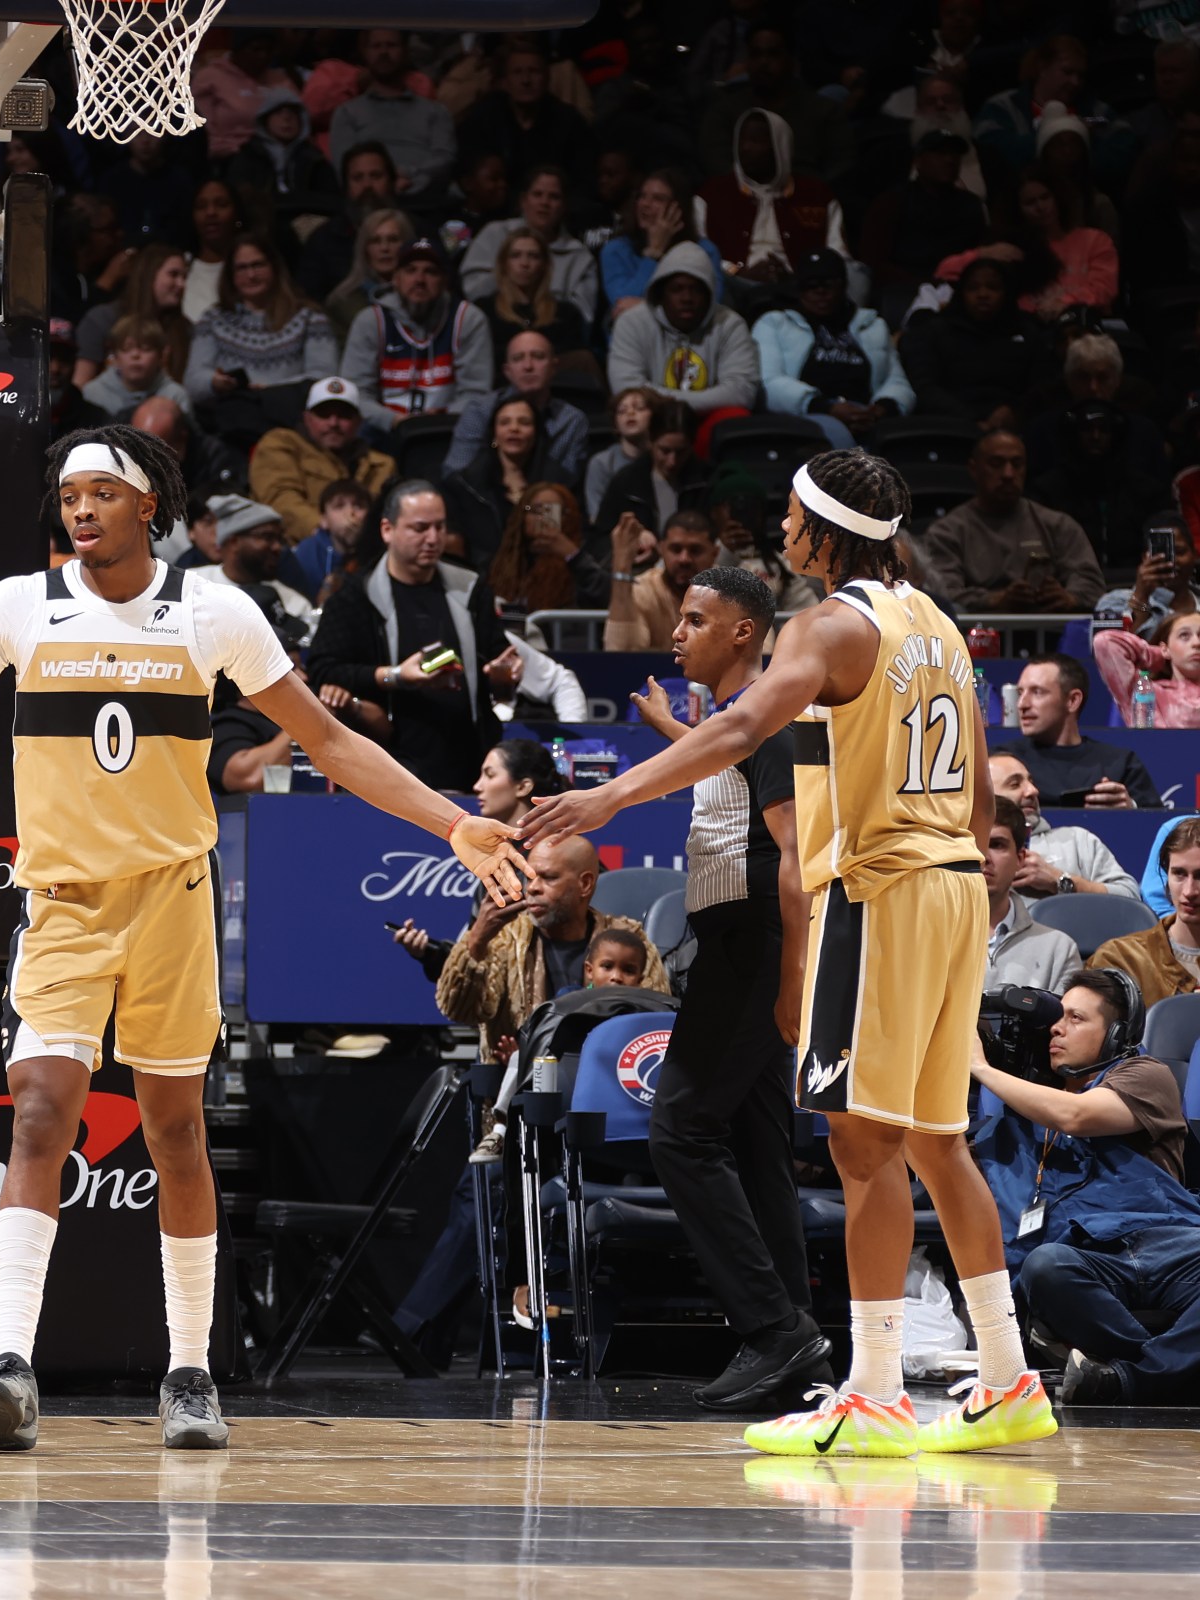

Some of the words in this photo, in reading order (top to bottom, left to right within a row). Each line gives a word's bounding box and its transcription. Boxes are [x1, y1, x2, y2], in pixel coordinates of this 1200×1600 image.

[141, 626, 180, 635] Robinhood
[40, 651, 184, 685] washington
[91, 701, 137, 774] 0
[896, 693, 967, 794] 12
